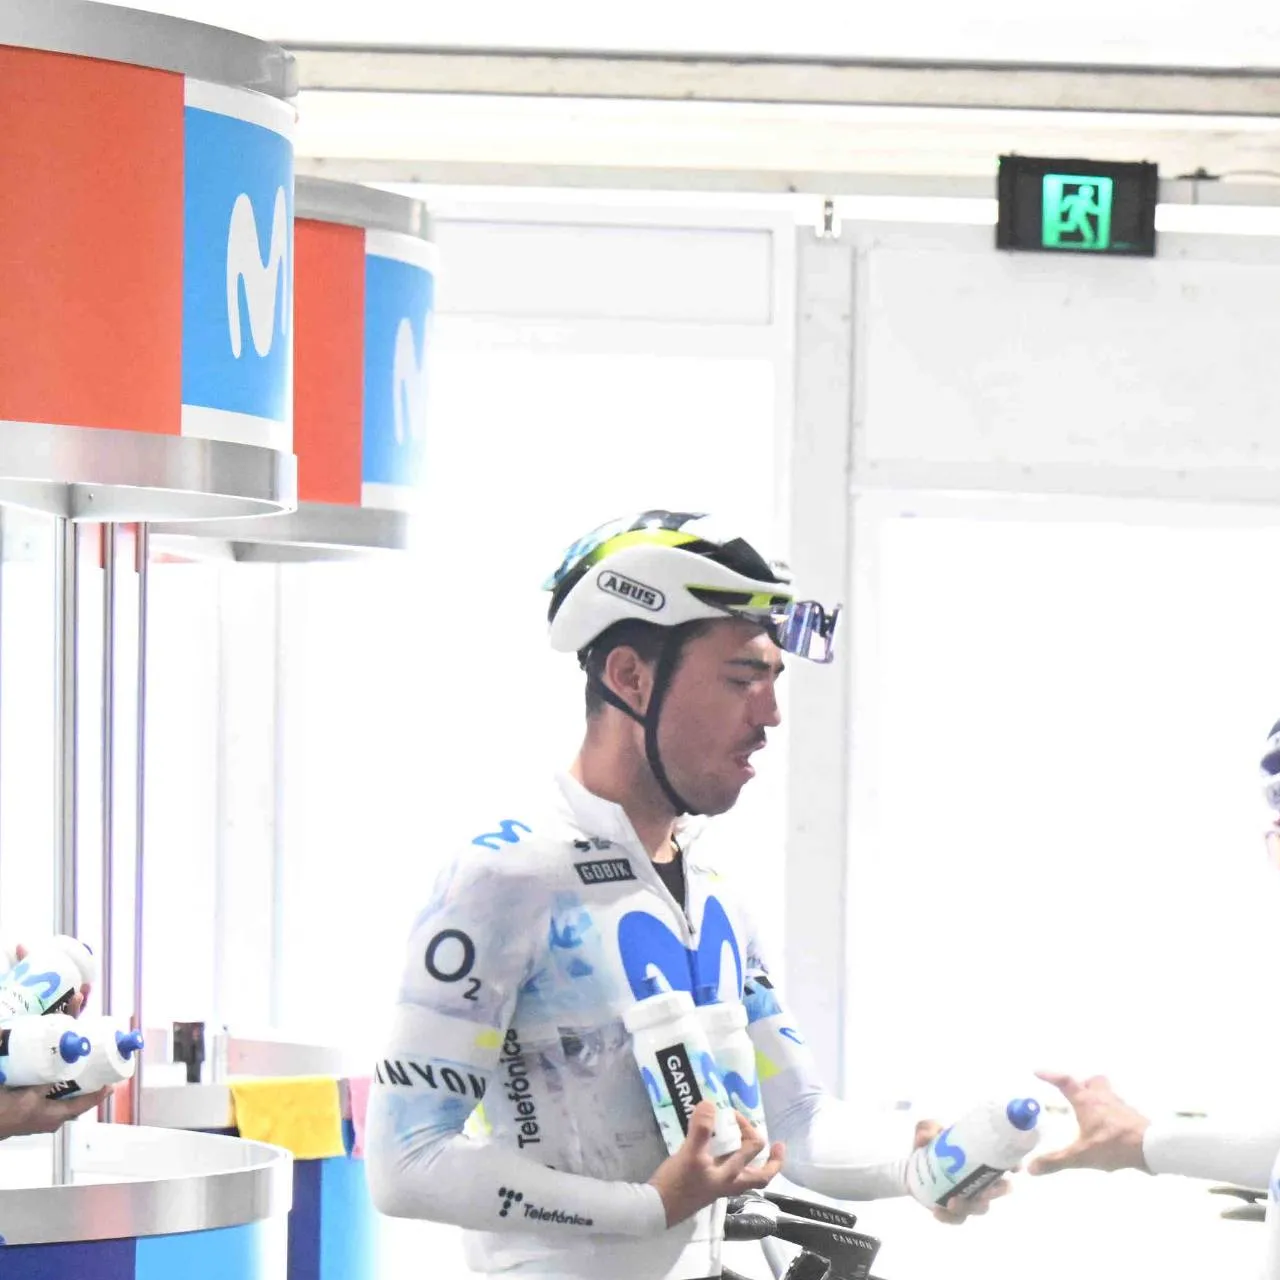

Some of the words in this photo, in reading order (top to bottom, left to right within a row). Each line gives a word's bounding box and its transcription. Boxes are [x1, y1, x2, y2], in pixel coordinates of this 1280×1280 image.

[604, 576, 656, 606] ABUS
[580, 862, 631, 881] GOBIK
[501, 1028, 541, 1149] Telefónica
[523, 1203, 594, 1227] Telefónica
[832, 1232, 874, 1251] CANYON
